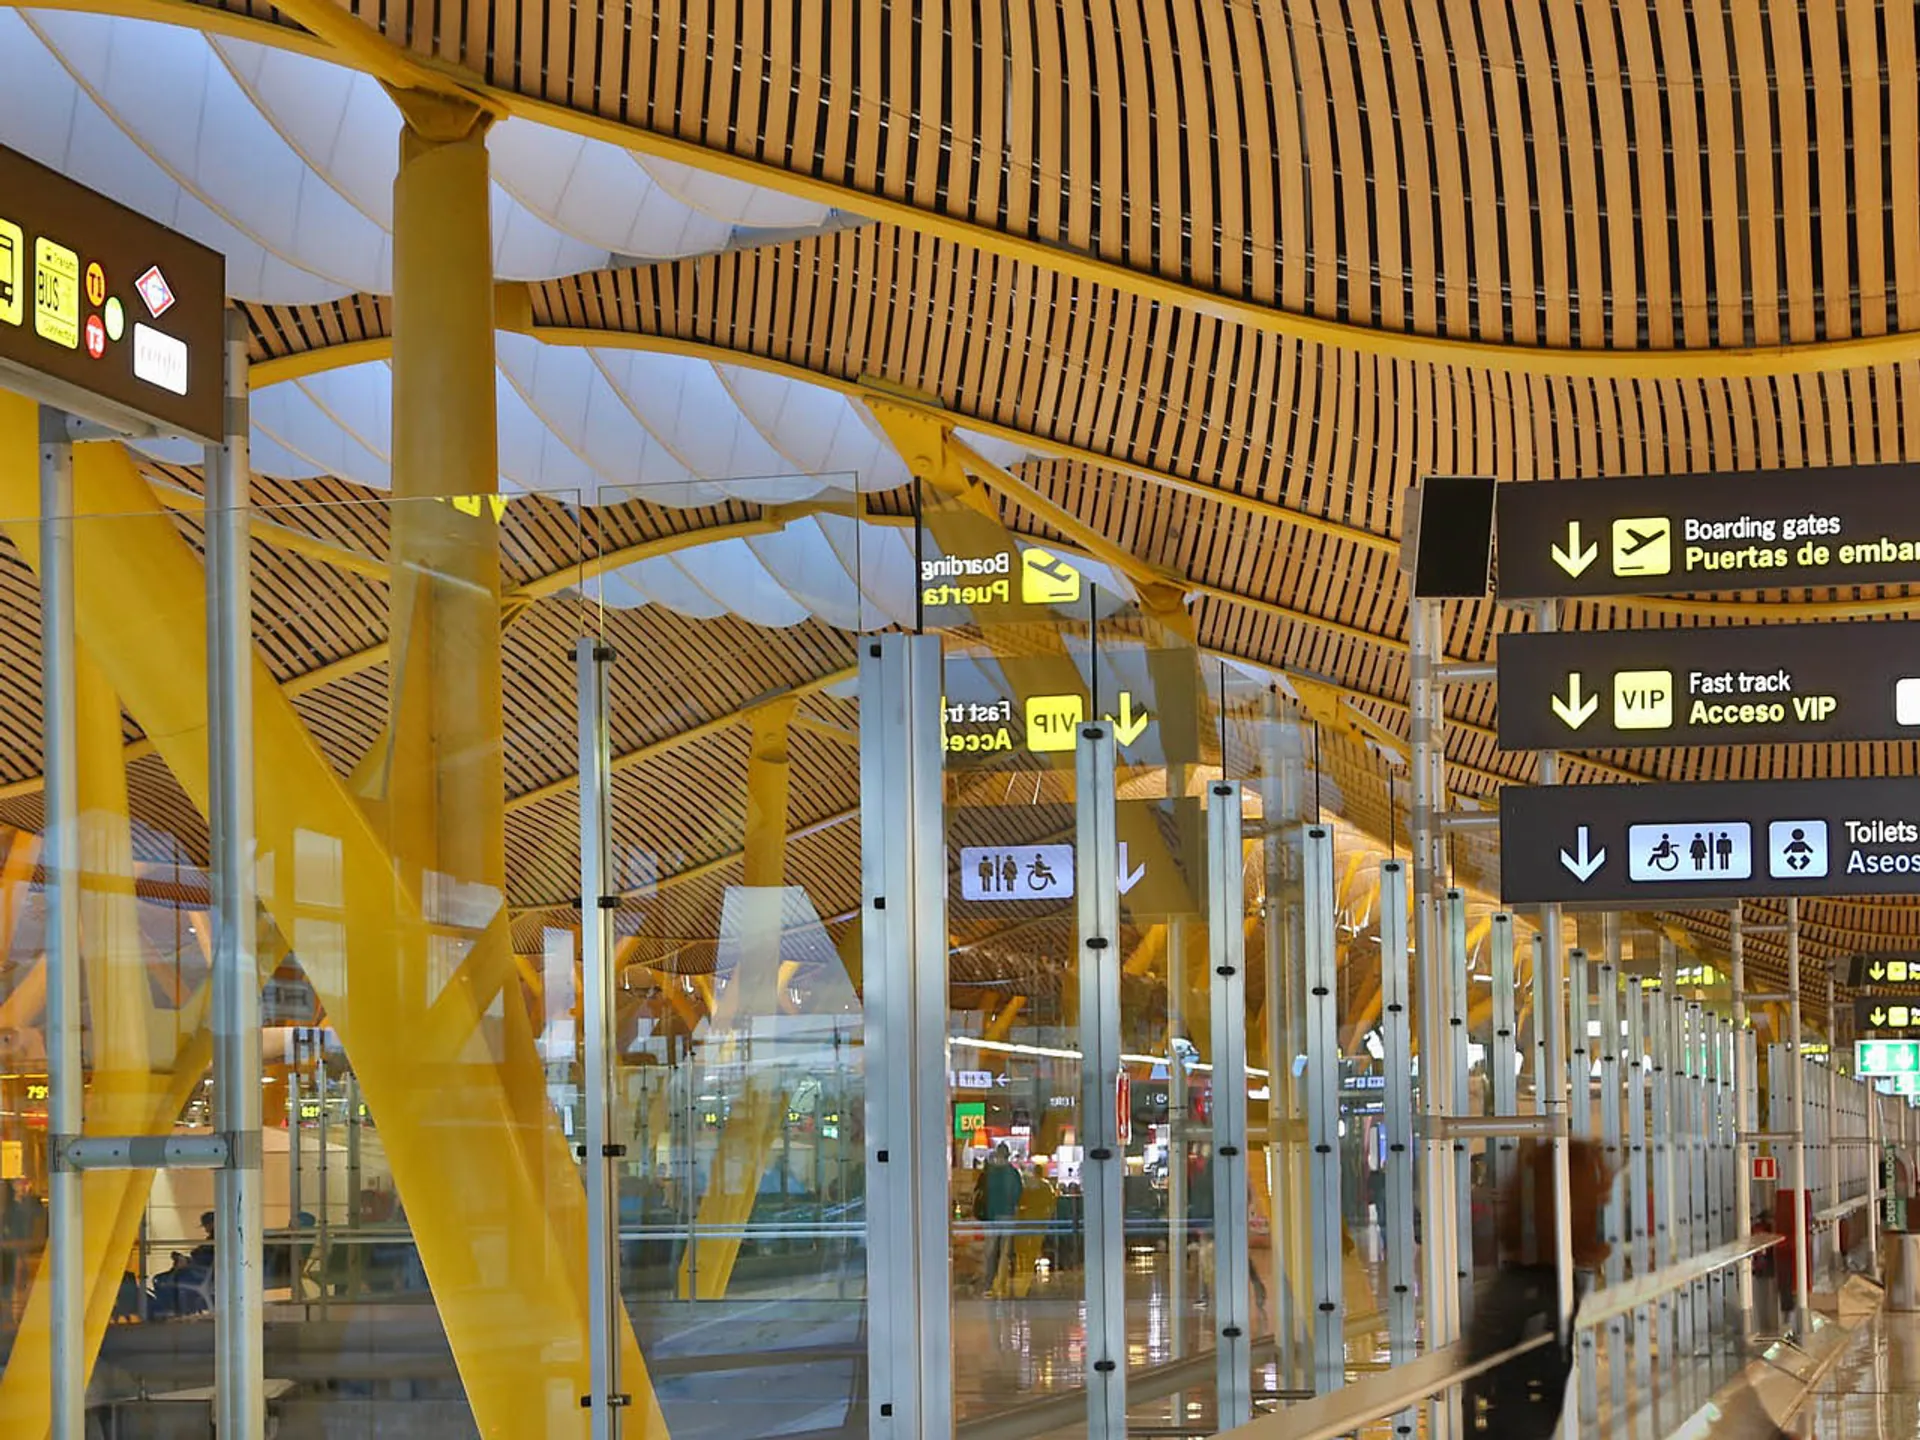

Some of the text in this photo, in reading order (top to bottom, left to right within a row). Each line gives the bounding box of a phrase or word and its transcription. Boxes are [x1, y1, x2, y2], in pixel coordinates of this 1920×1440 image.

[38, 269, 59, 312] BUS
[88, 271, 103, 299] T1
[87, 324, 105, 354] T3
[1685, 513, 1841, 542] Boarding gates
[1686, 545, 1788, 572] Puertas
[1797, 541, 1829, 566] de
[1689, 669, 1791, 694] Fast track
[1622, 689, 1665, 709] VIP
[1689, 695, 1837, 725] Acceso VIP
[1844, 820, 1918, 843] Toilets
[1846, 850, 1920, 874] Aseos
